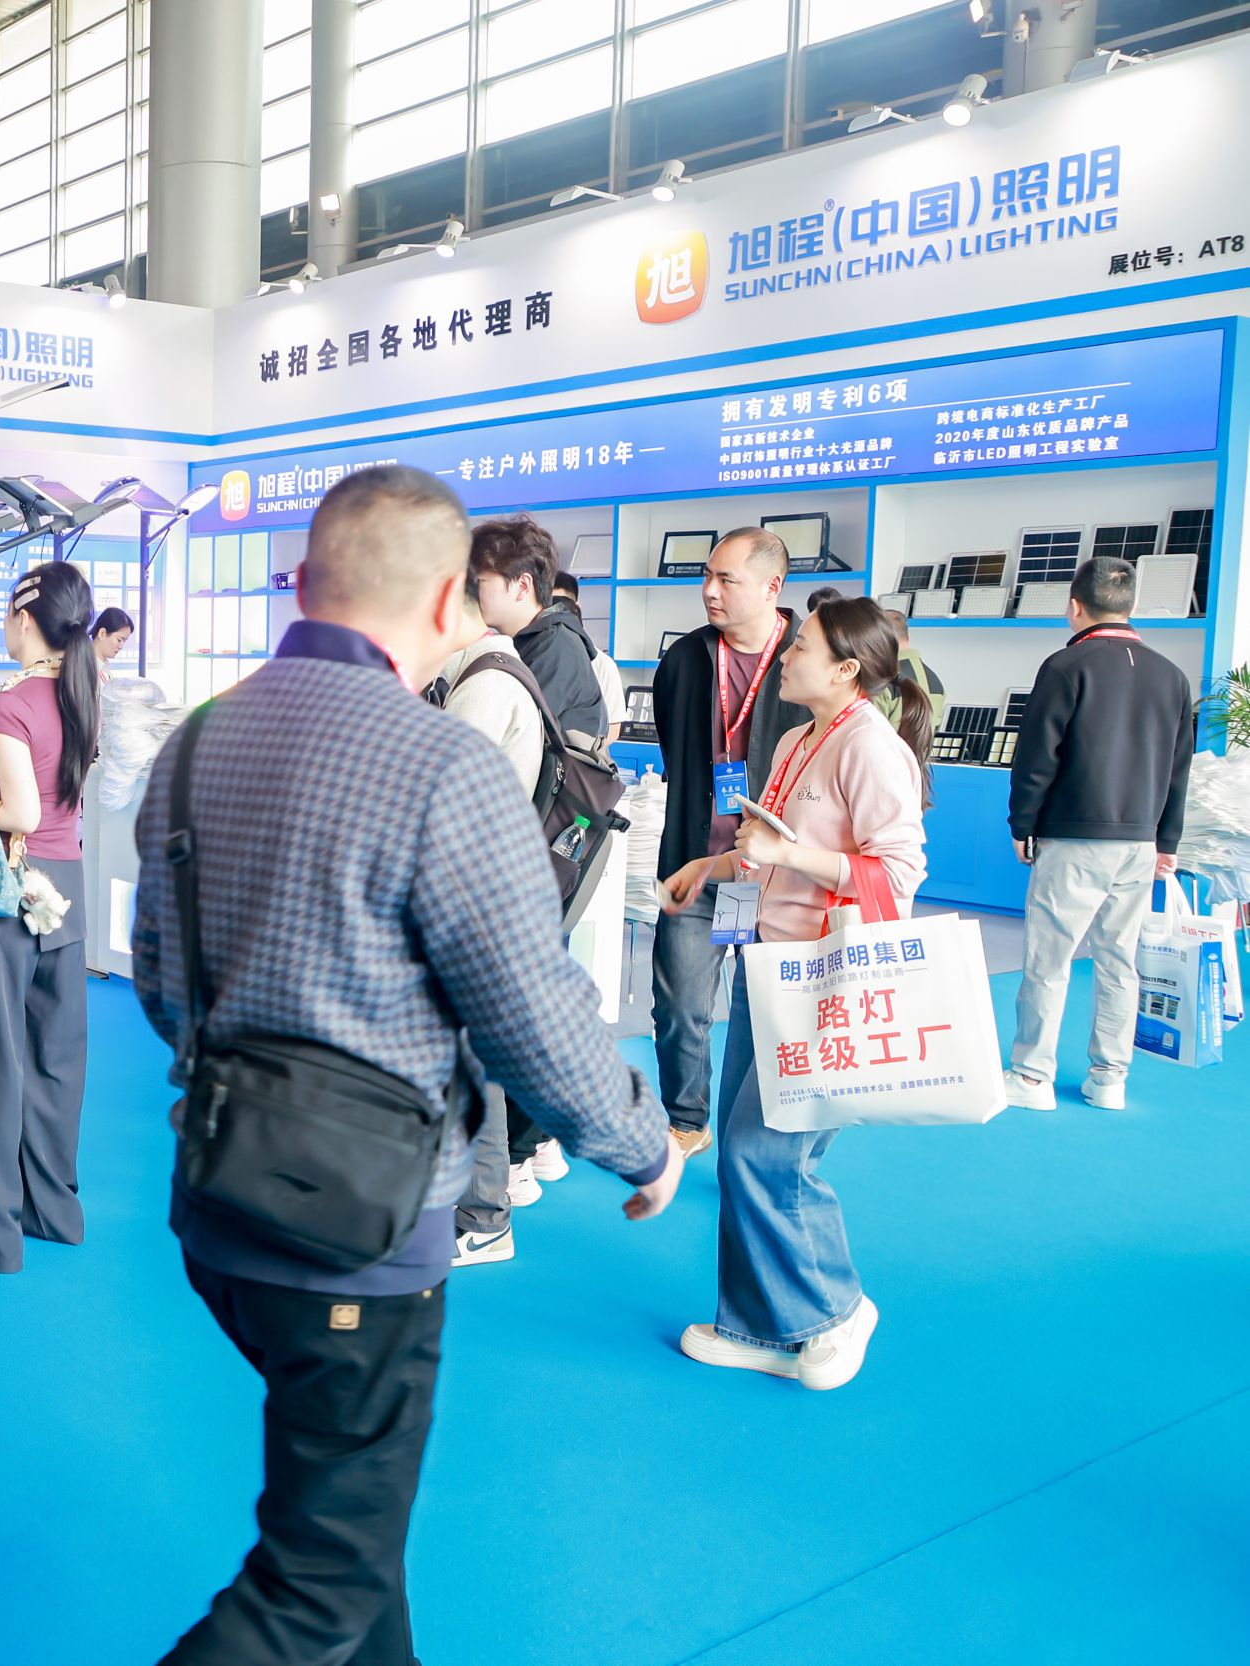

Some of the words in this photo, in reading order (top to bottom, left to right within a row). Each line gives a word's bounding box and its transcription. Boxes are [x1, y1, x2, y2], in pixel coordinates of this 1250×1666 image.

[728, 145, 1122, 274] 旭程(中国)照明
[725, 208, 1118, 302] SUNCHN(CHINA)LIGHTING
[646, 246, 696, 309] 旭
[259, 291, 552, 382] 诚招全国各地代理商
[722, 378, 908, 424] 拥有发明专利6项
[936, 395, 1106, 426] 跨境电商标准化生产工厂
[720, 427, 815, 448] 国家高新技术企业
[934, 436, 1120, 464] 临沂市LED照明工程实验室
[935, 414, 1128, 445] 2020年度山东优质品牌产品
[718, 456, 896, 482] ISO9001质量管理体系认证工厂
[720, 437, 892, 466] 中国灯饰照明行业十大光源品牌
[780, 938, 926, 982] 朗朔照明集团
[816, 988, 896, 1031] 路灯
[776, 1024, 952, 1078] 超级工厂
[830, 1083, 893, 1096] 国家高新技术企业
[900, 1074, 964, 1090] 道路照明资质齐全
